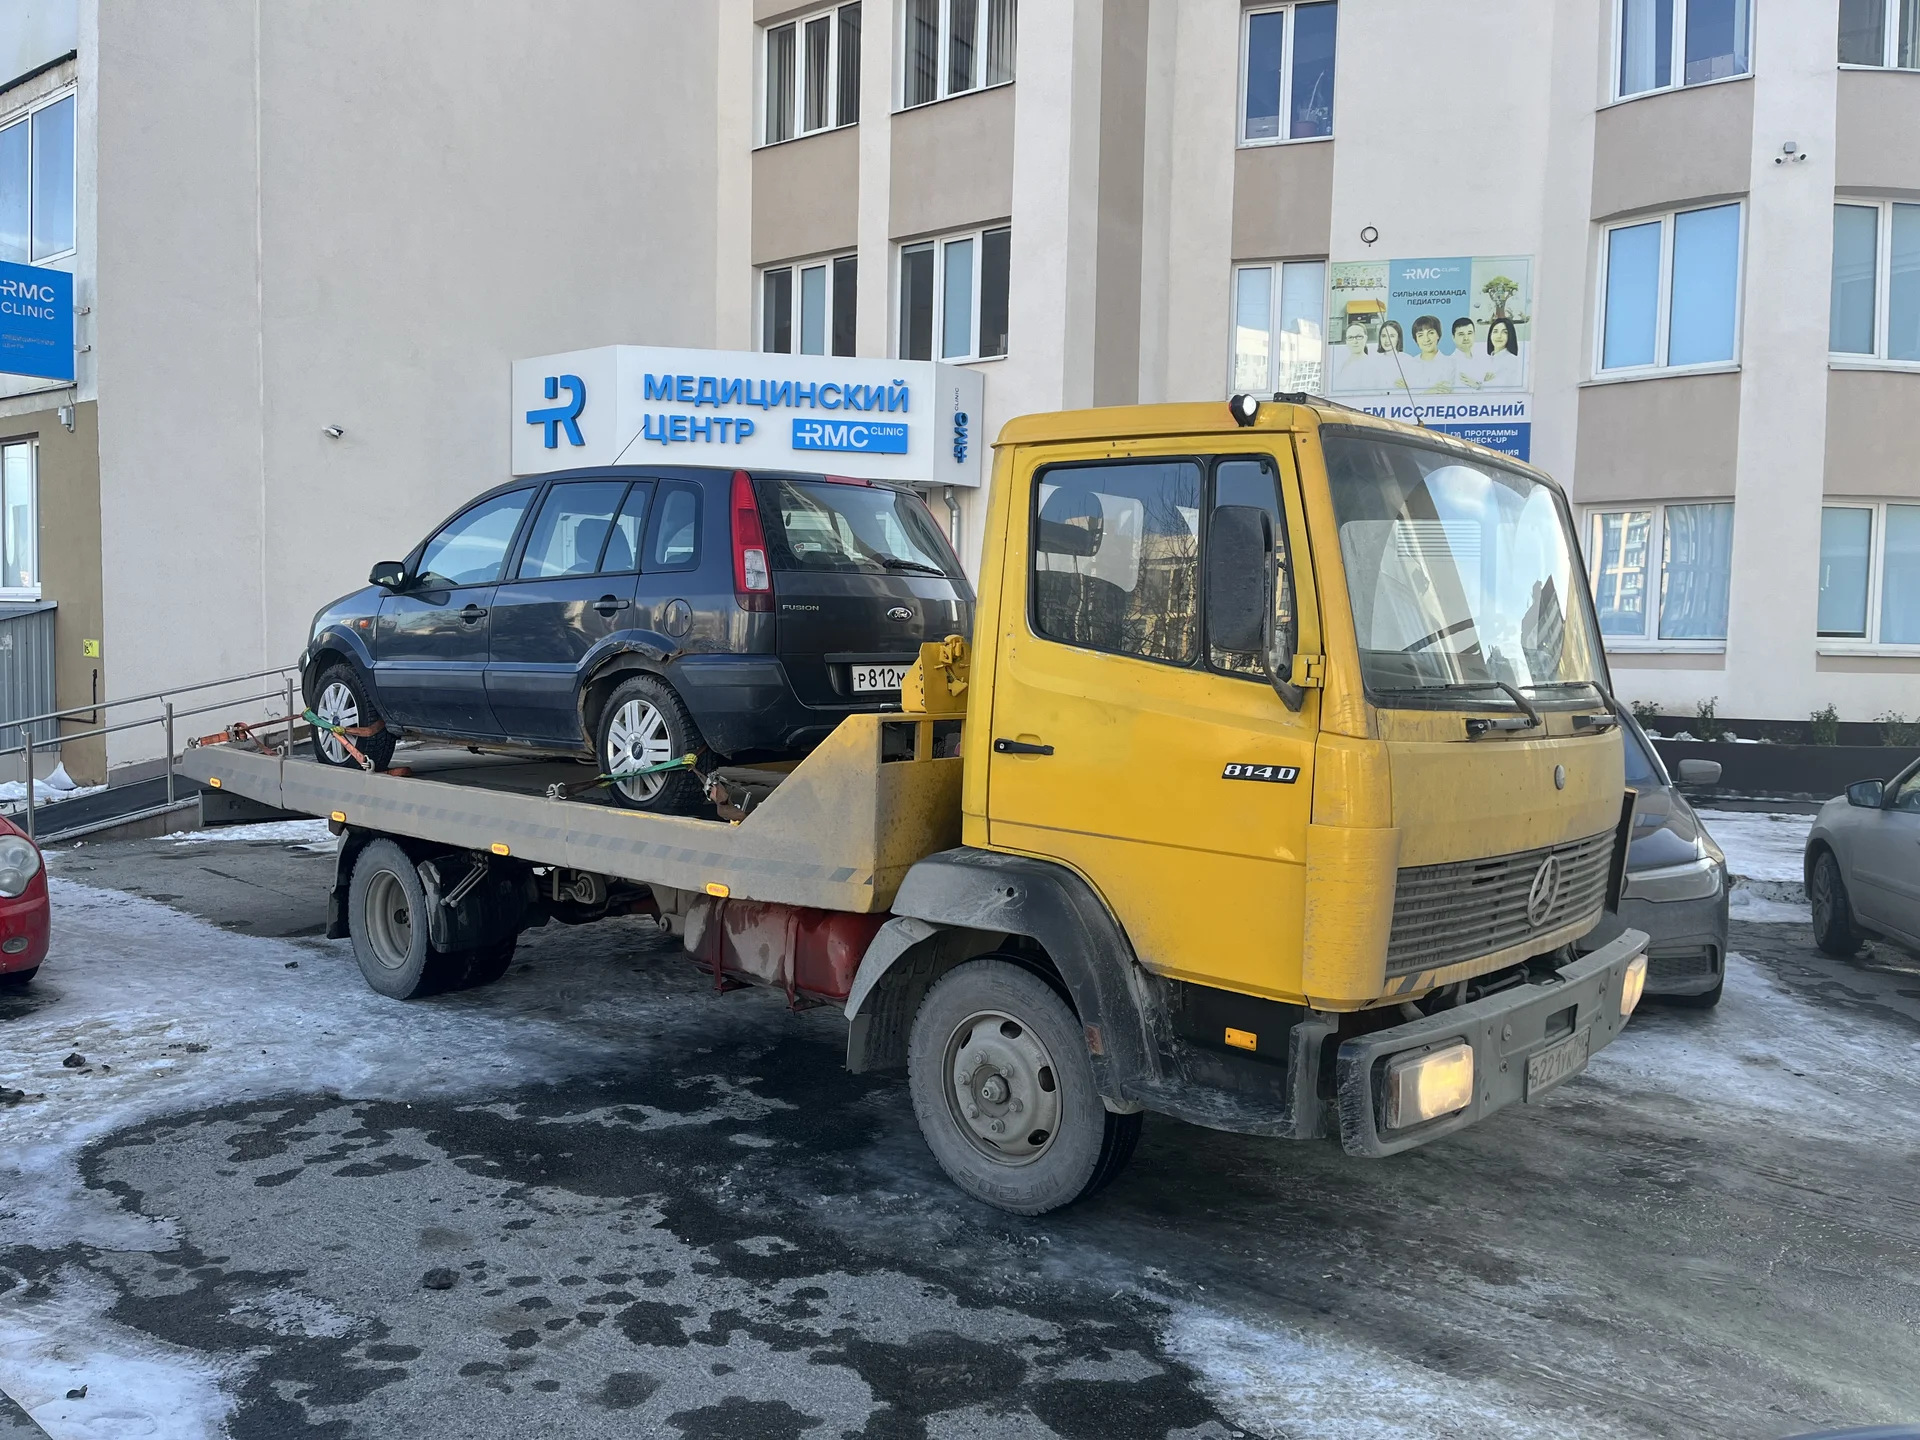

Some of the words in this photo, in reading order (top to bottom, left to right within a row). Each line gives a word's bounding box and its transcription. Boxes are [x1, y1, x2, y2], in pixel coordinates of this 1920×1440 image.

[1402, 268, 1441, 280] RMC
[0, 280, 54, 302] RMC
[1392, 290, 1428, 298] СИЛЬНАЯ
[1429, 289, 1467, 297] КОМАНДА
[1, 302, 54, 320] CLINIC
[1407, 298, 1452, 306] ПЕДИАТРОВ
[644, 373, 909, 413] МЕДИЦИНСКИЙ
[1391, 401, 1525, 419] ИССЛЕДОВАНИЙ
[644, 414, 755, 446] ЦЕНТР
[797, 423, 869, 448] RMC
[870, 426, 904, 437] CLINIC
[1464, 429, 1519, 437] ПРОГРАММЫ
[1224, 764, 1273, 778] 814
[1277, 767, 1296, 780] D
